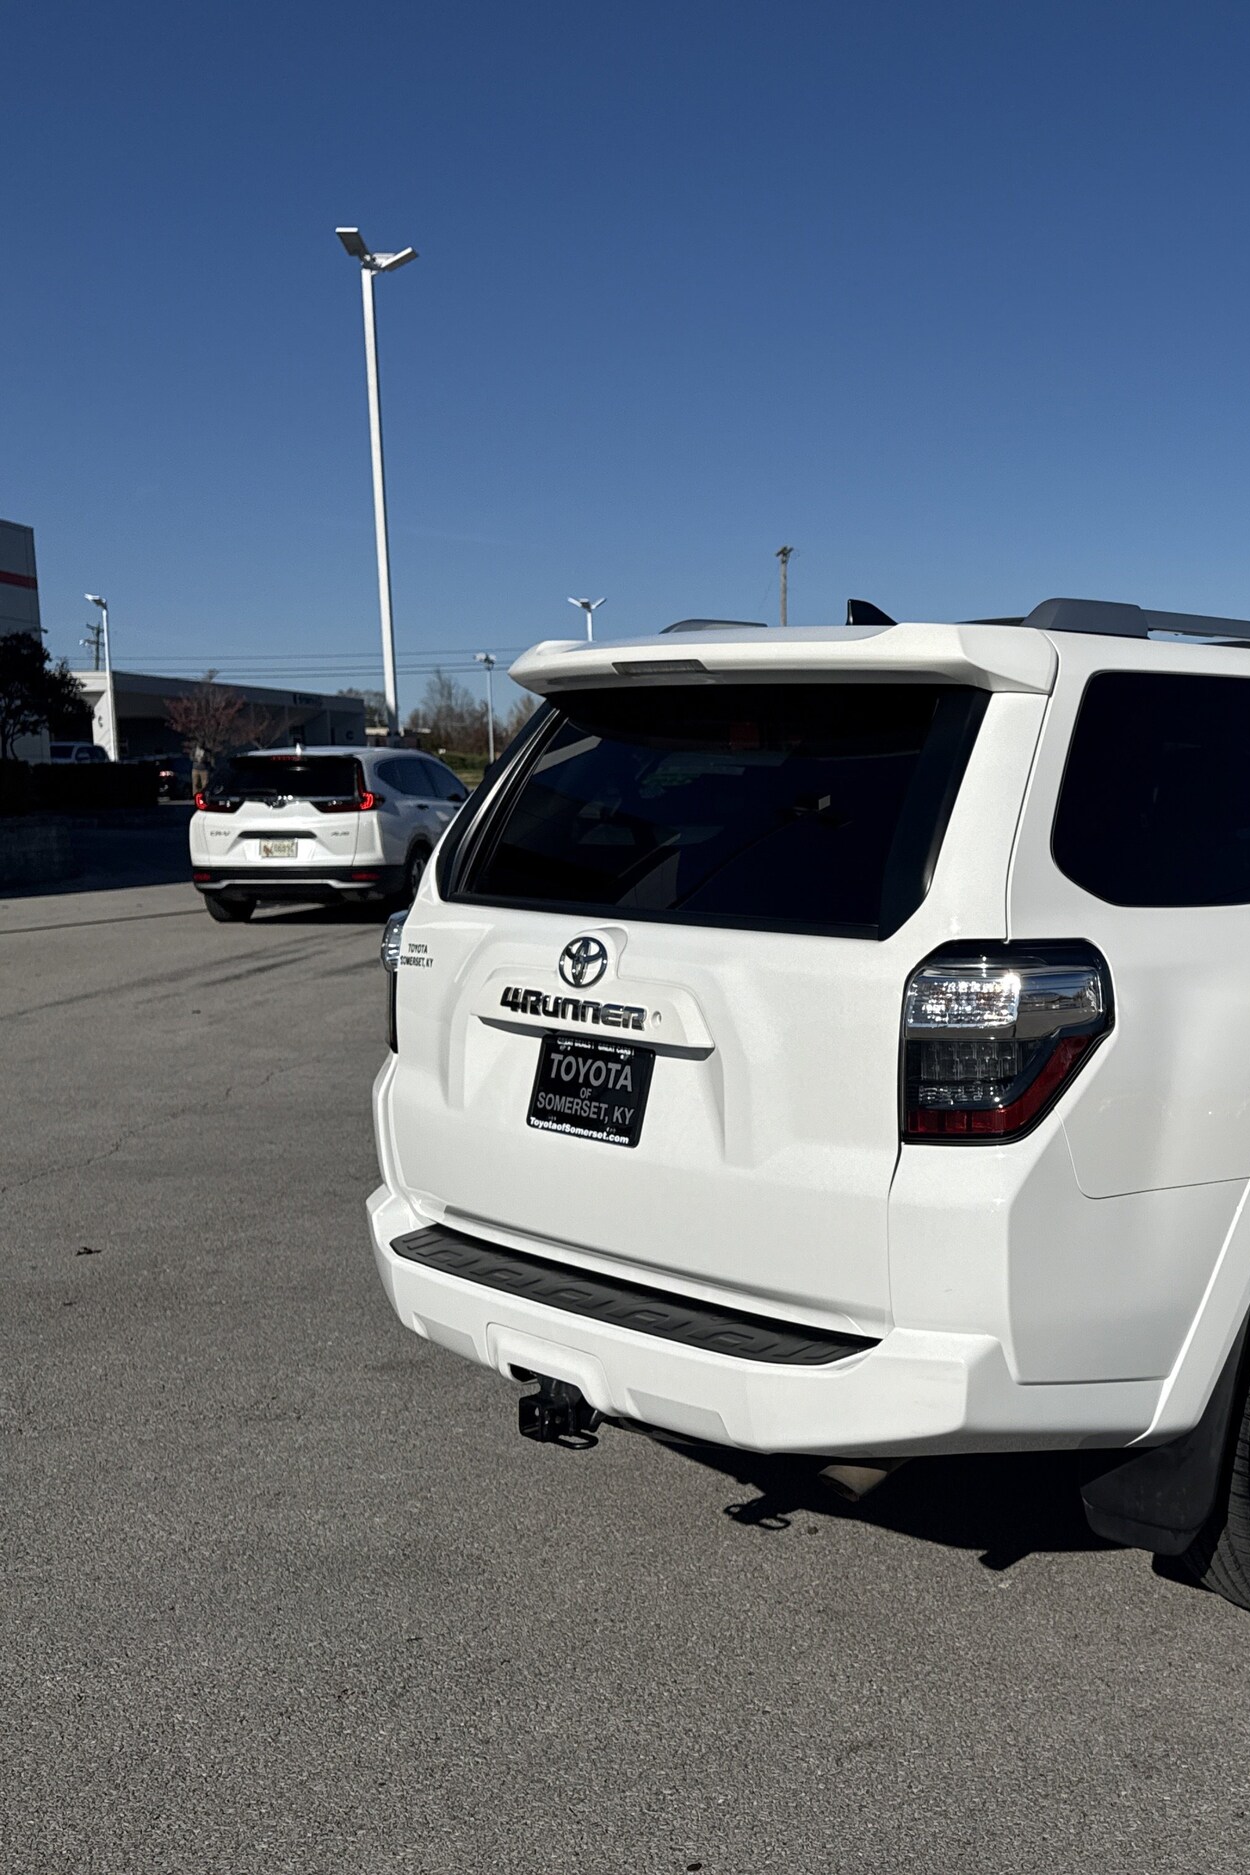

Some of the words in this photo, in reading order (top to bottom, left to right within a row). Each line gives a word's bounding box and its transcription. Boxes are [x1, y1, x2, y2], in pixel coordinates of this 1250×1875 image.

[408, 943, 428, 953] TOYOTA
[426, 958, 434, 967] KY
[549, 1053, 633, 1093] TOYOTA
[580, 1087, 592, 1099] OF
[536, 1092, 609, 1124] SOMERSET,
[612, 1106, 635, 1125] KY
[530, 1117, 629, 1144] ToyotaofSomerset.com
